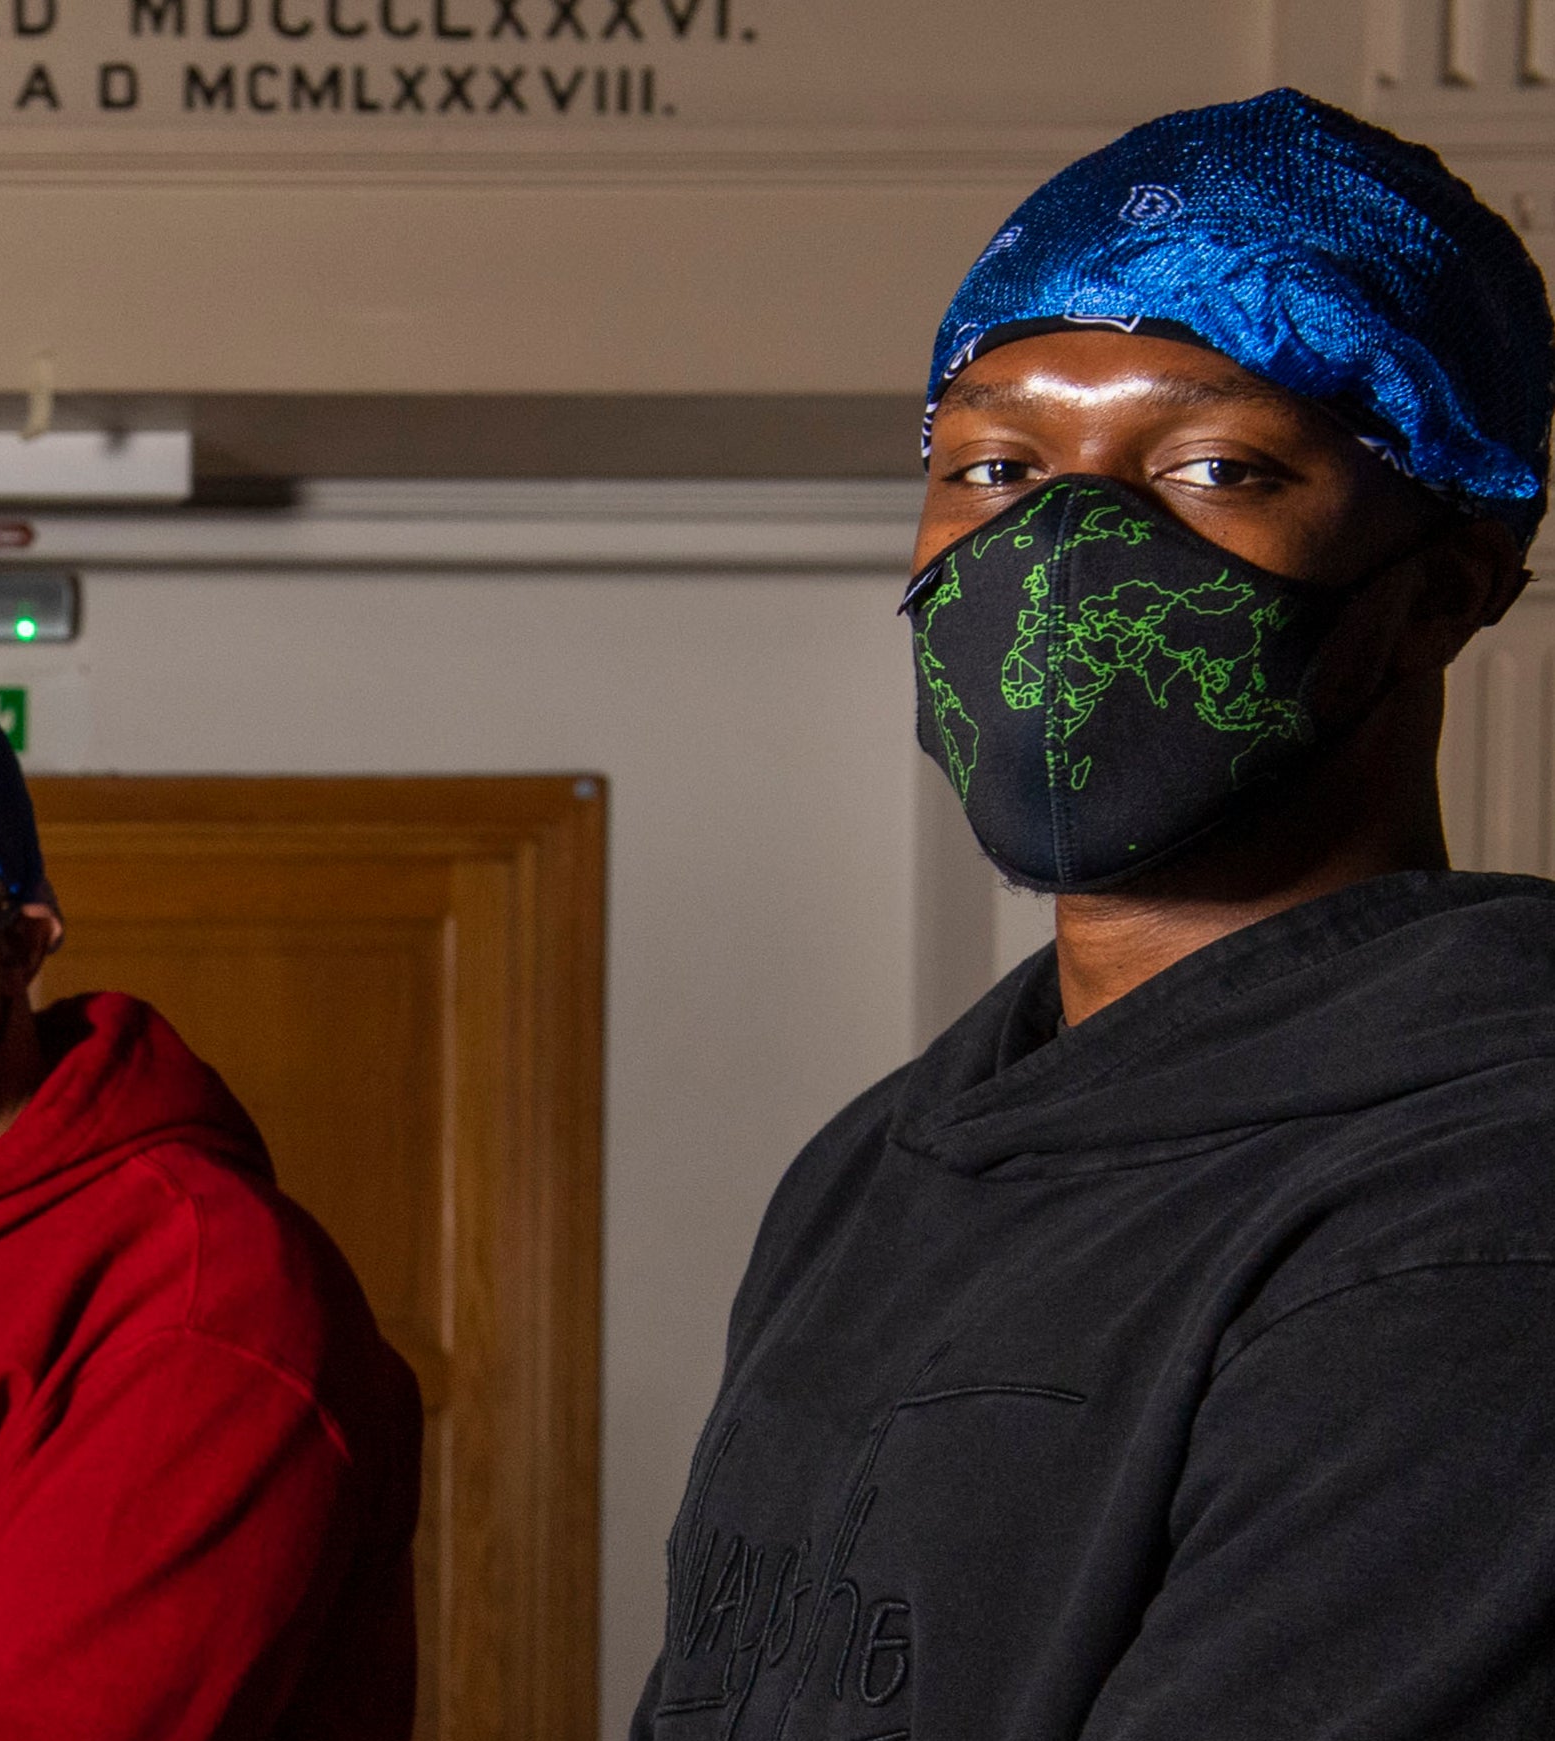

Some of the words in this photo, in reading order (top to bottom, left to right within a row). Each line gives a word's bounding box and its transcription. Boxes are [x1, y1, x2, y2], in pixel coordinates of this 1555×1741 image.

[13, 61, 64, 113] A
[96, 60, 142, 114] D
[181, 62, 677, 117] MCMLXXXVIII.
